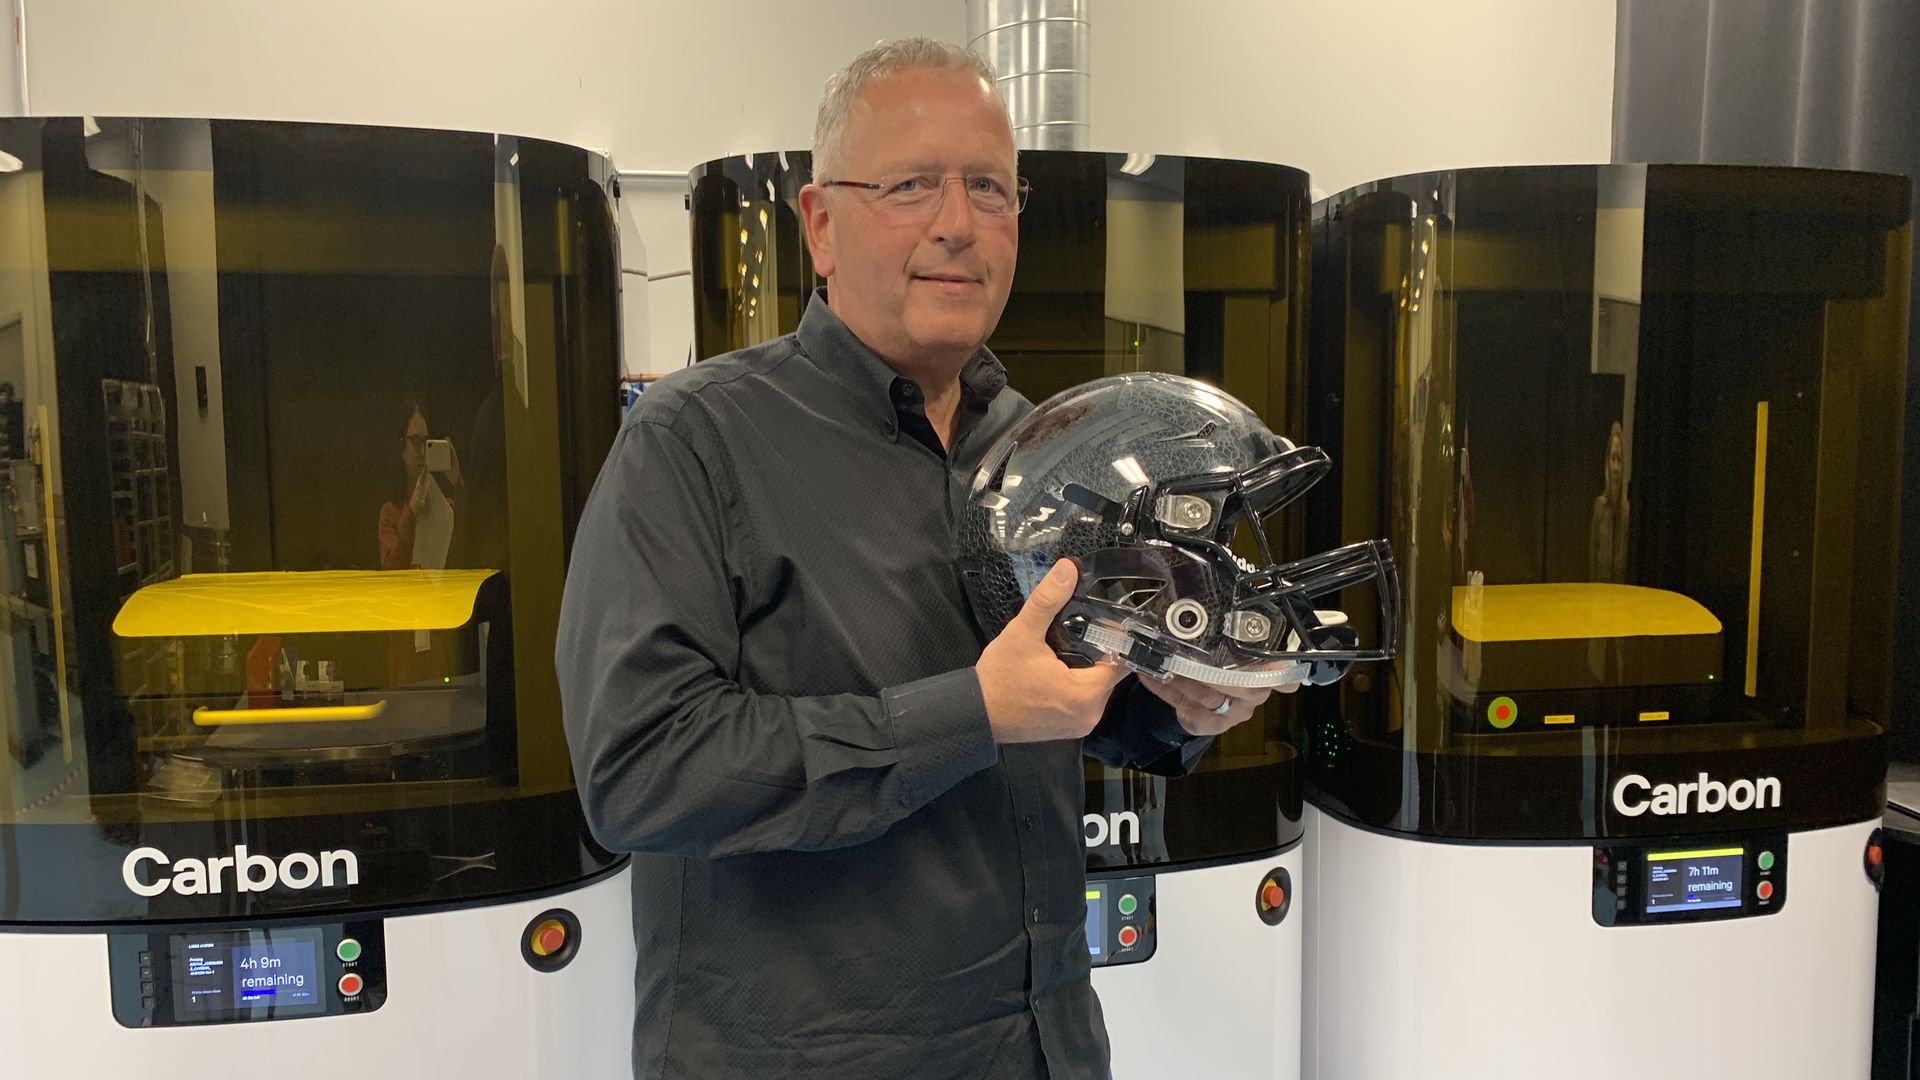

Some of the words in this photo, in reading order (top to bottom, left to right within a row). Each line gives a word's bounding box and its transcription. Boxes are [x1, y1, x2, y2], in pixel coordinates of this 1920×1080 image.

[1613, 772, 1781, 817] Carbon
[122, 844, 359, 897] Carbon
[1688, 866, 1700, 877] 7h
[1702, 866, 1719, 876] 11m
[1688, 881, 1733, 892] remaining
[240, 957, 257, 970] 4h
[260, 956, 281, 969] 9m
[241, 973, 304, 988] remaining
